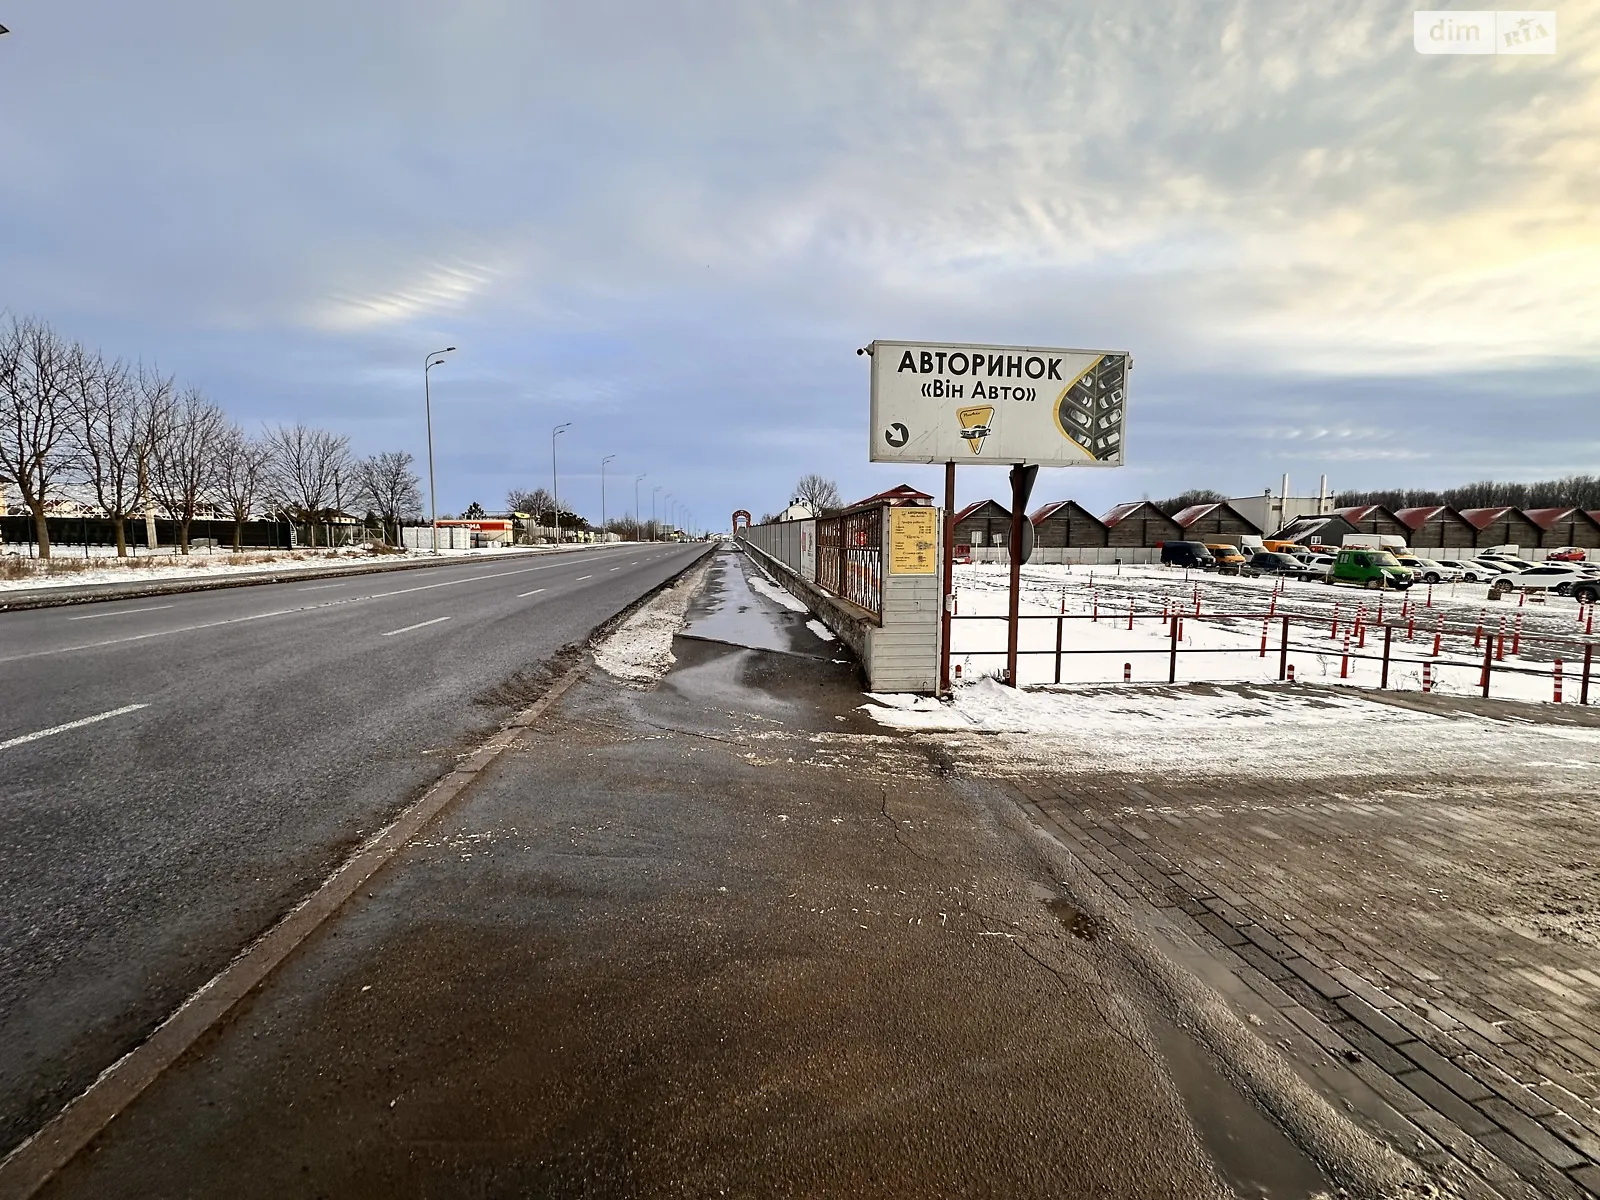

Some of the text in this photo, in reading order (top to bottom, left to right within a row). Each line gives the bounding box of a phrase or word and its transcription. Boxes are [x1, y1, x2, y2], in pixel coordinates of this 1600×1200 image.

[897, 350, 1062, 380] АВТОРИНОК
[921, 379, 1037, 402] «Він Авто»
